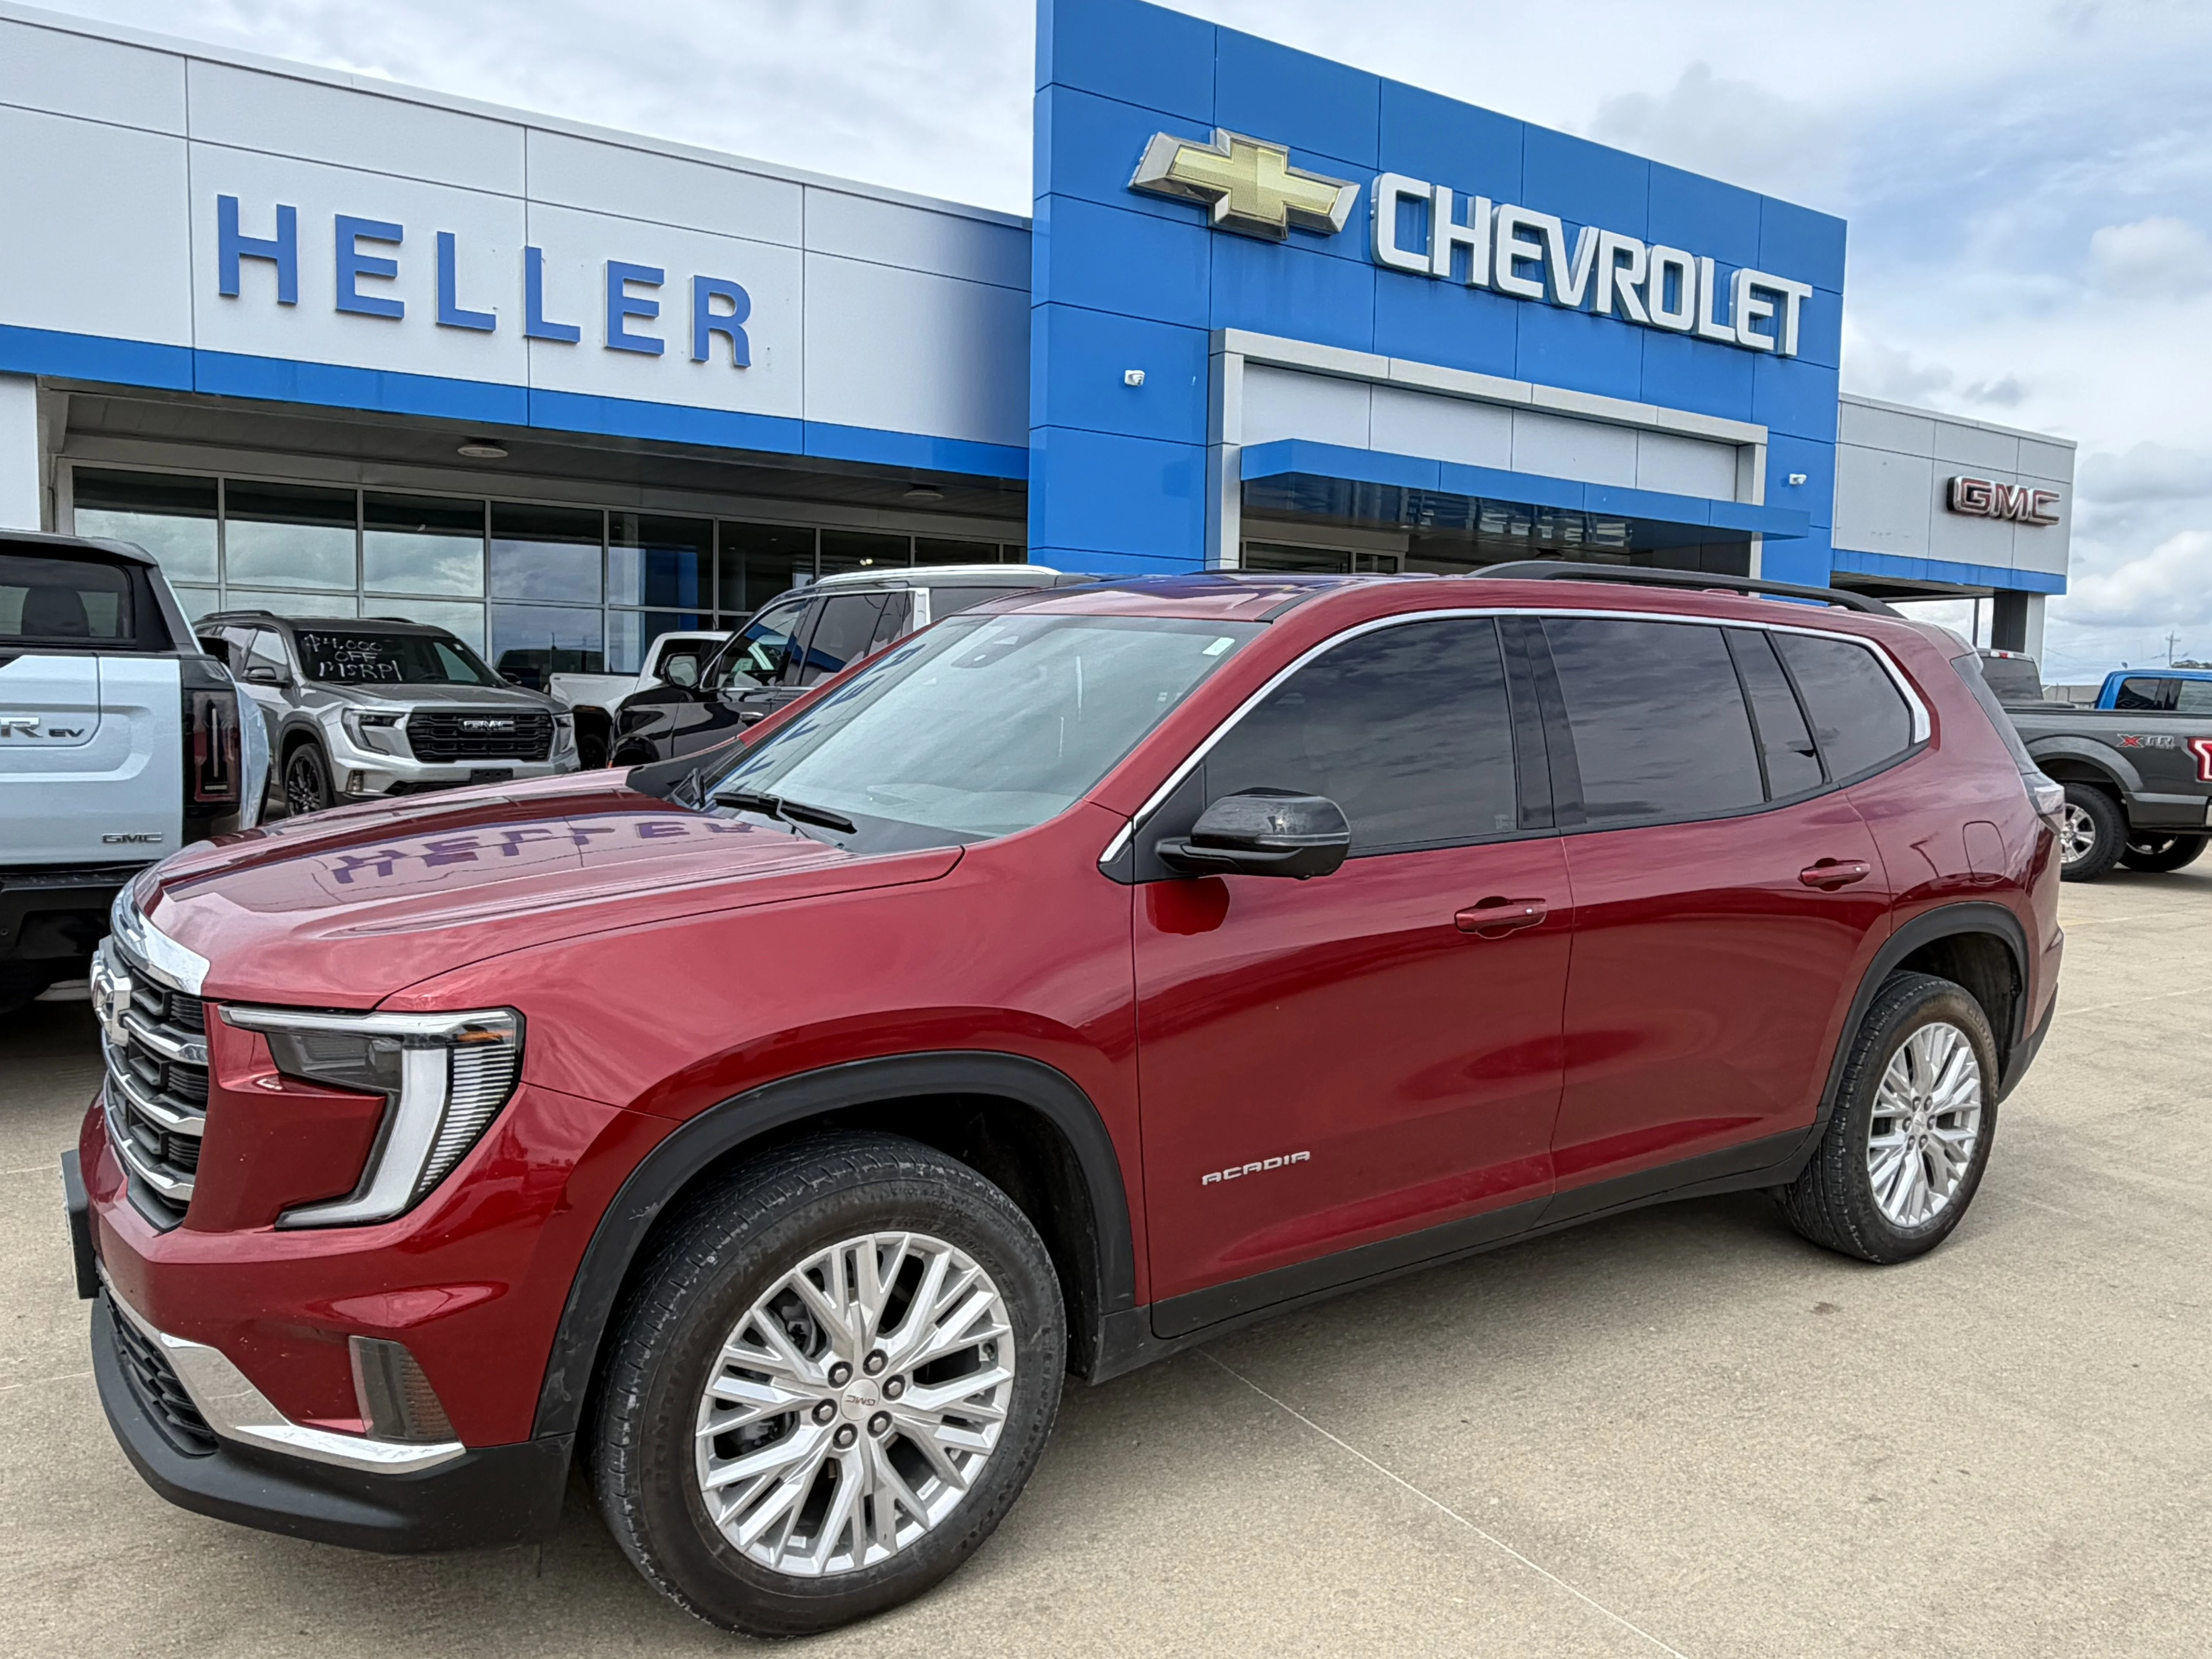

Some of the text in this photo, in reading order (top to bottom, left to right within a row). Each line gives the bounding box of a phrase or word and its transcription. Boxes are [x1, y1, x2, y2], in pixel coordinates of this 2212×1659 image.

[1371, 172, 1813, 357] CHEVROLET
[217, 194, 752, 368] HELLER
[1947, 476, 2061, 525] GMC
[335, 651, 378, 662] OFF
[48, 728, 85, 737] EV
[101, 832, 162, 843] GMC
[1202, 1151, 1310, 1185] ACADIA
[845, 1395, 876, 1406] GMC
